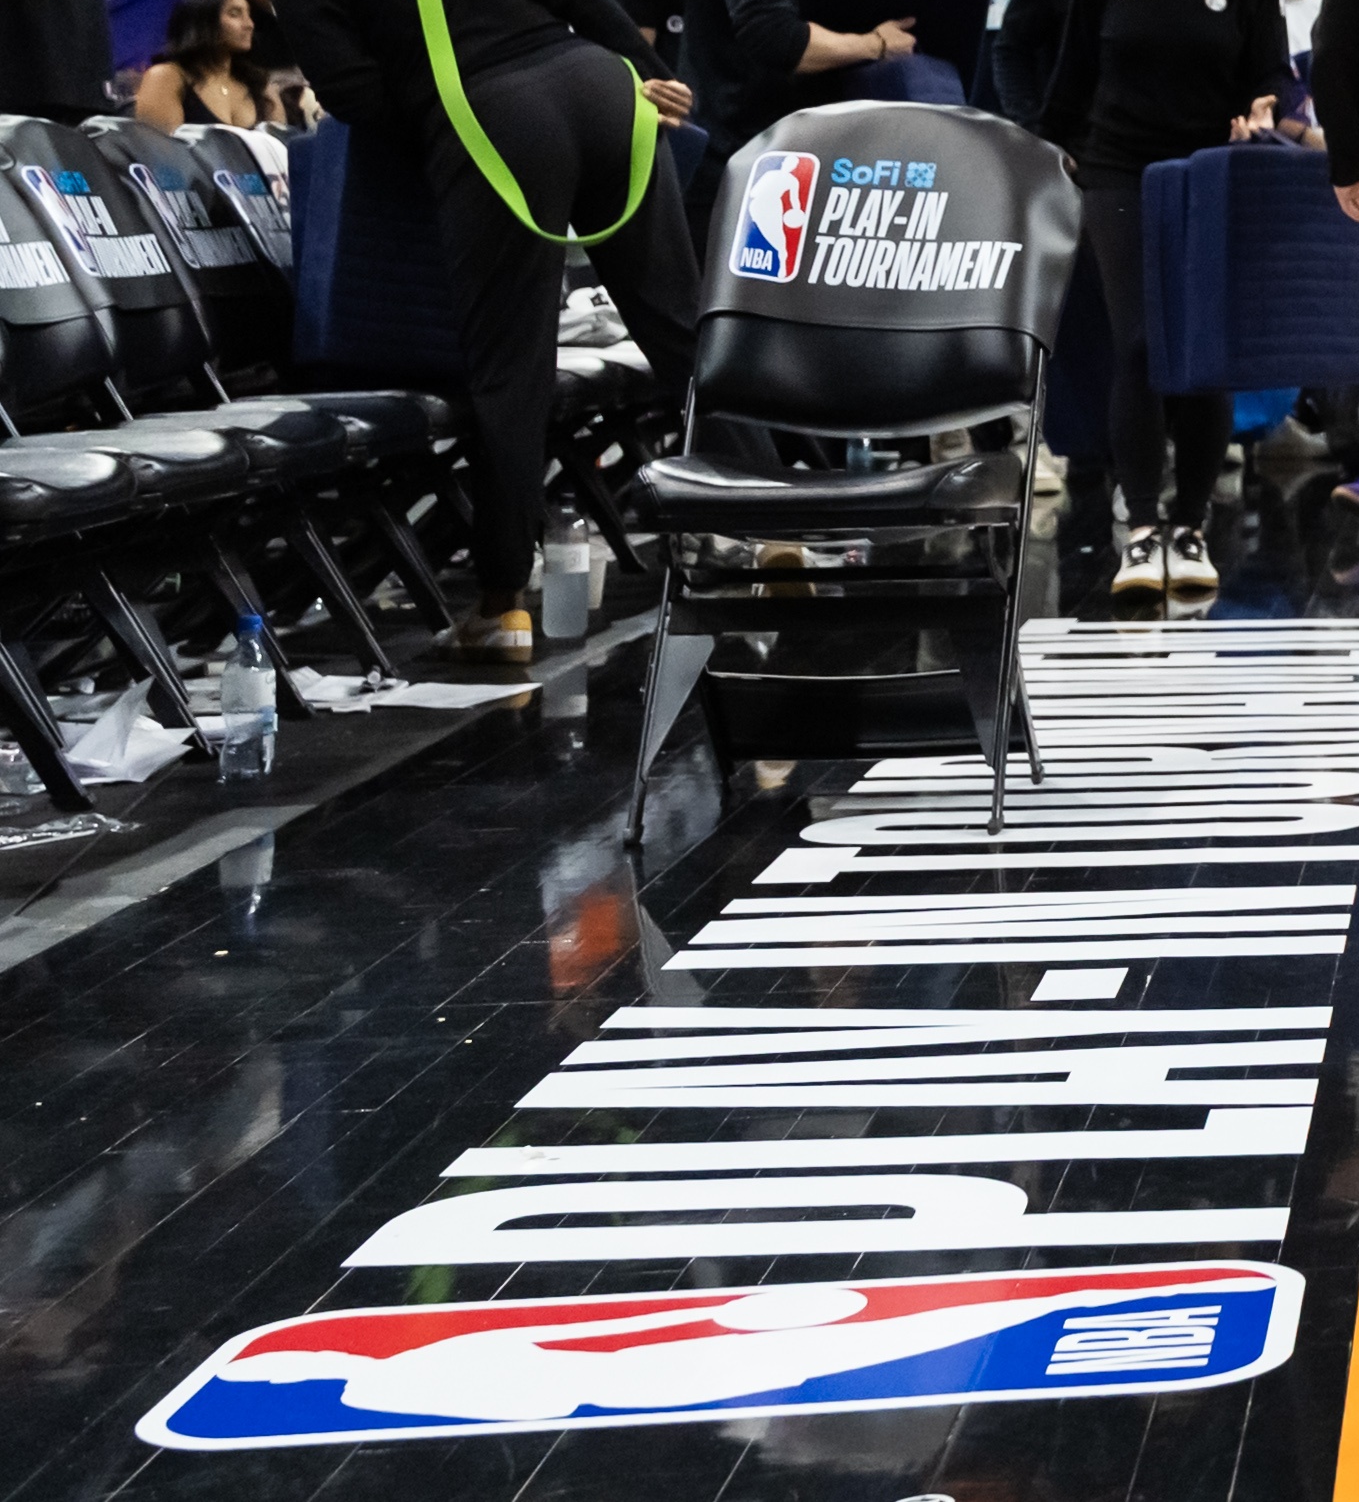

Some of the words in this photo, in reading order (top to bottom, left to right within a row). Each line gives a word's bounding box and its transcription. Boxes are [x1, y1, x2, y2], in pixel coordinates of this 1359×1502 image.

[831, 157, 902, 187] SoFi
[818, 186, 949, 241] PLAY-IN
[740, 247, 774, 272] NBA
[807, 236, 1023, 292] TOURNAMENT
[340, 884, 1358, 1269] PLAY-IN
[1044, 1304, 1223, 1376] NBA
